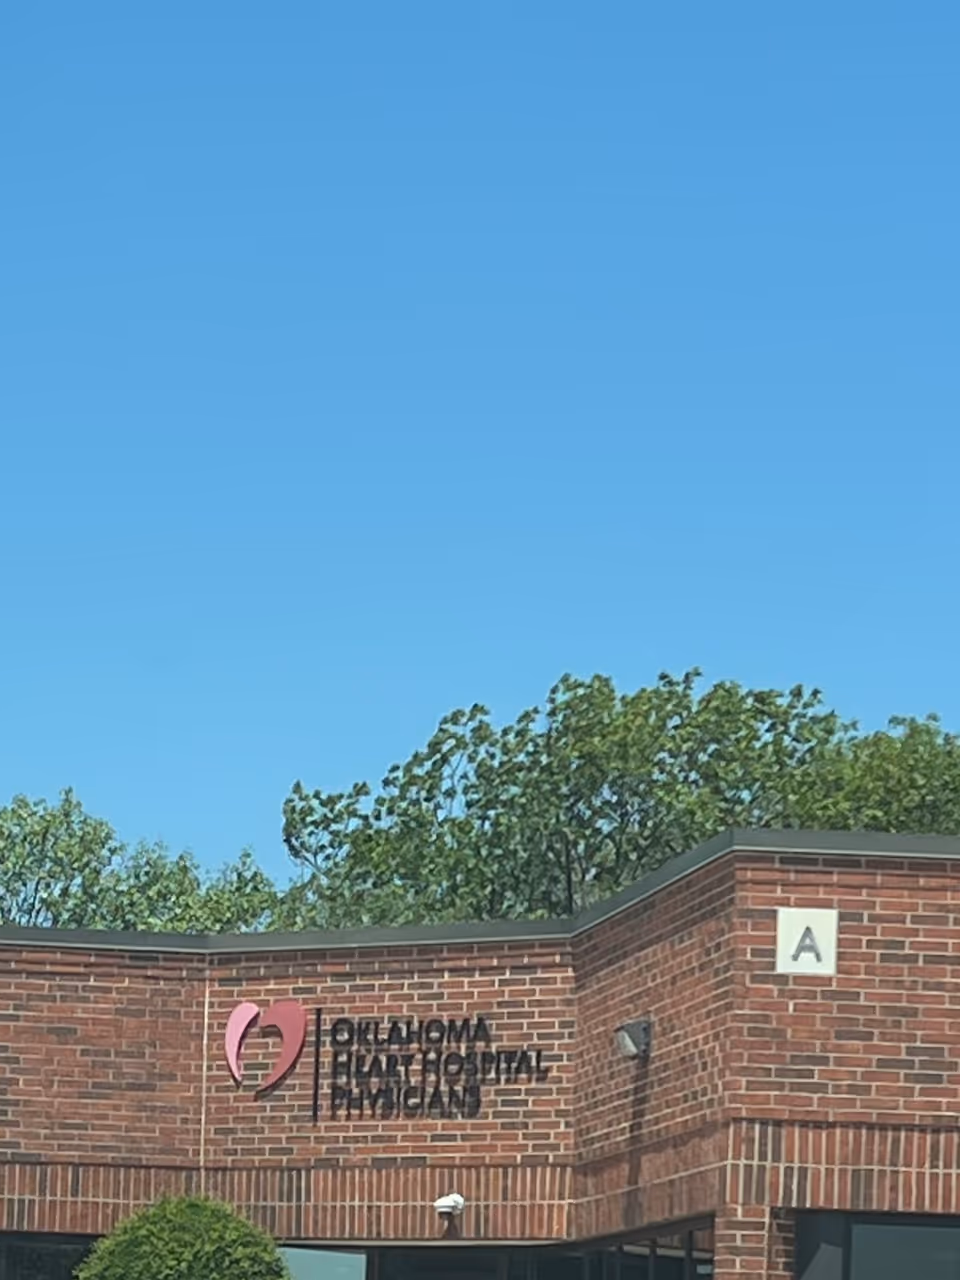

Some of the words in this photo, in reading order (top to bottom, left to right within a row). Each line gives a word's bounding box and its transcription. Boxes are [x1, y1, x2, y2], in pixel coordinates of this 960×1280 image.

[791, 925, 823, 963] A
[331, 1017, 491, 1049] OKLAHOMA
[331, 1051, 415, 1083] HEART
[422, 1050, 548, 1083] HOSPITAL
[331, 1085, 482, 1120] PHYSICIANS
